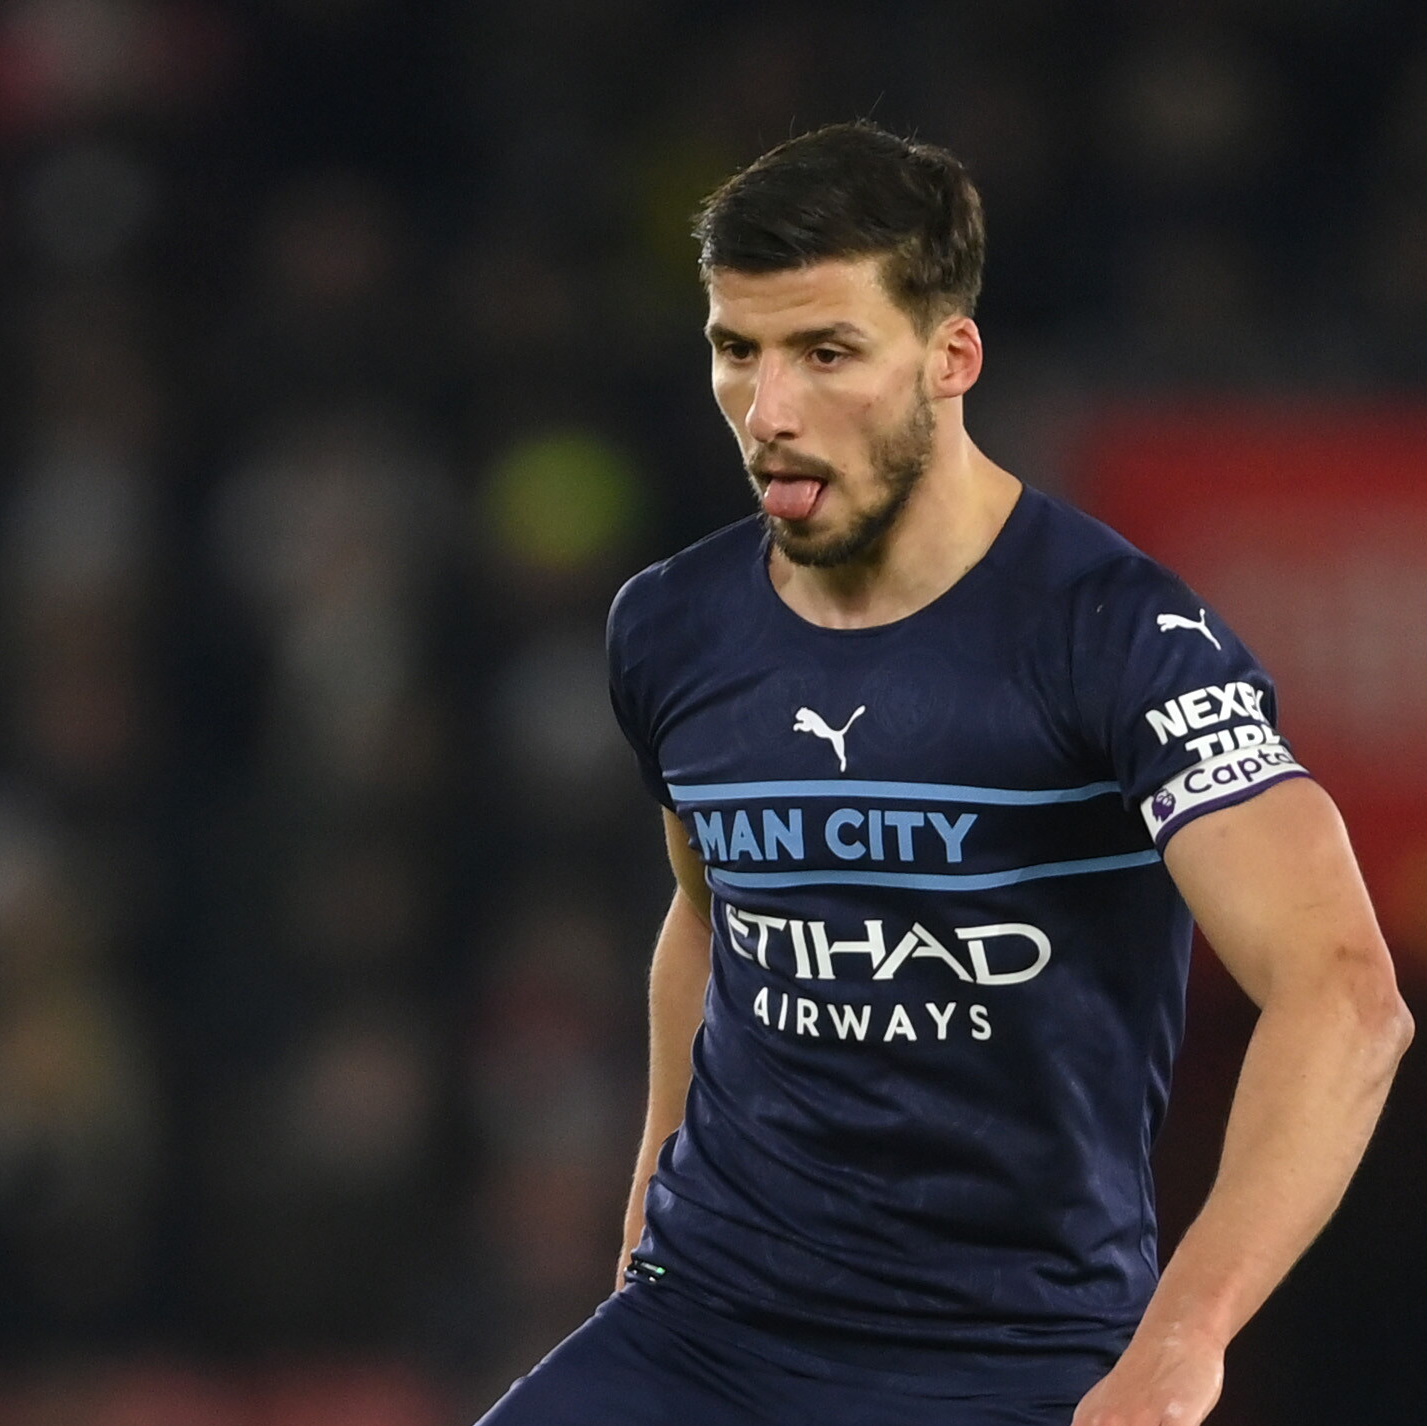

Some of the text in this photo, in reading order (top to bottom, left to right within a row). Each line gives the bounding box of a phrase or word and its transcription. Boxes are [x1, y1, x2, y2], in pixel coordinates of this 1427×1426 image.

[692, 807, 979, 864] MAN CITY
[725, 903, 1053, 986] ETIHAD
[752, 986, 993, 1042] AIRWAYS
